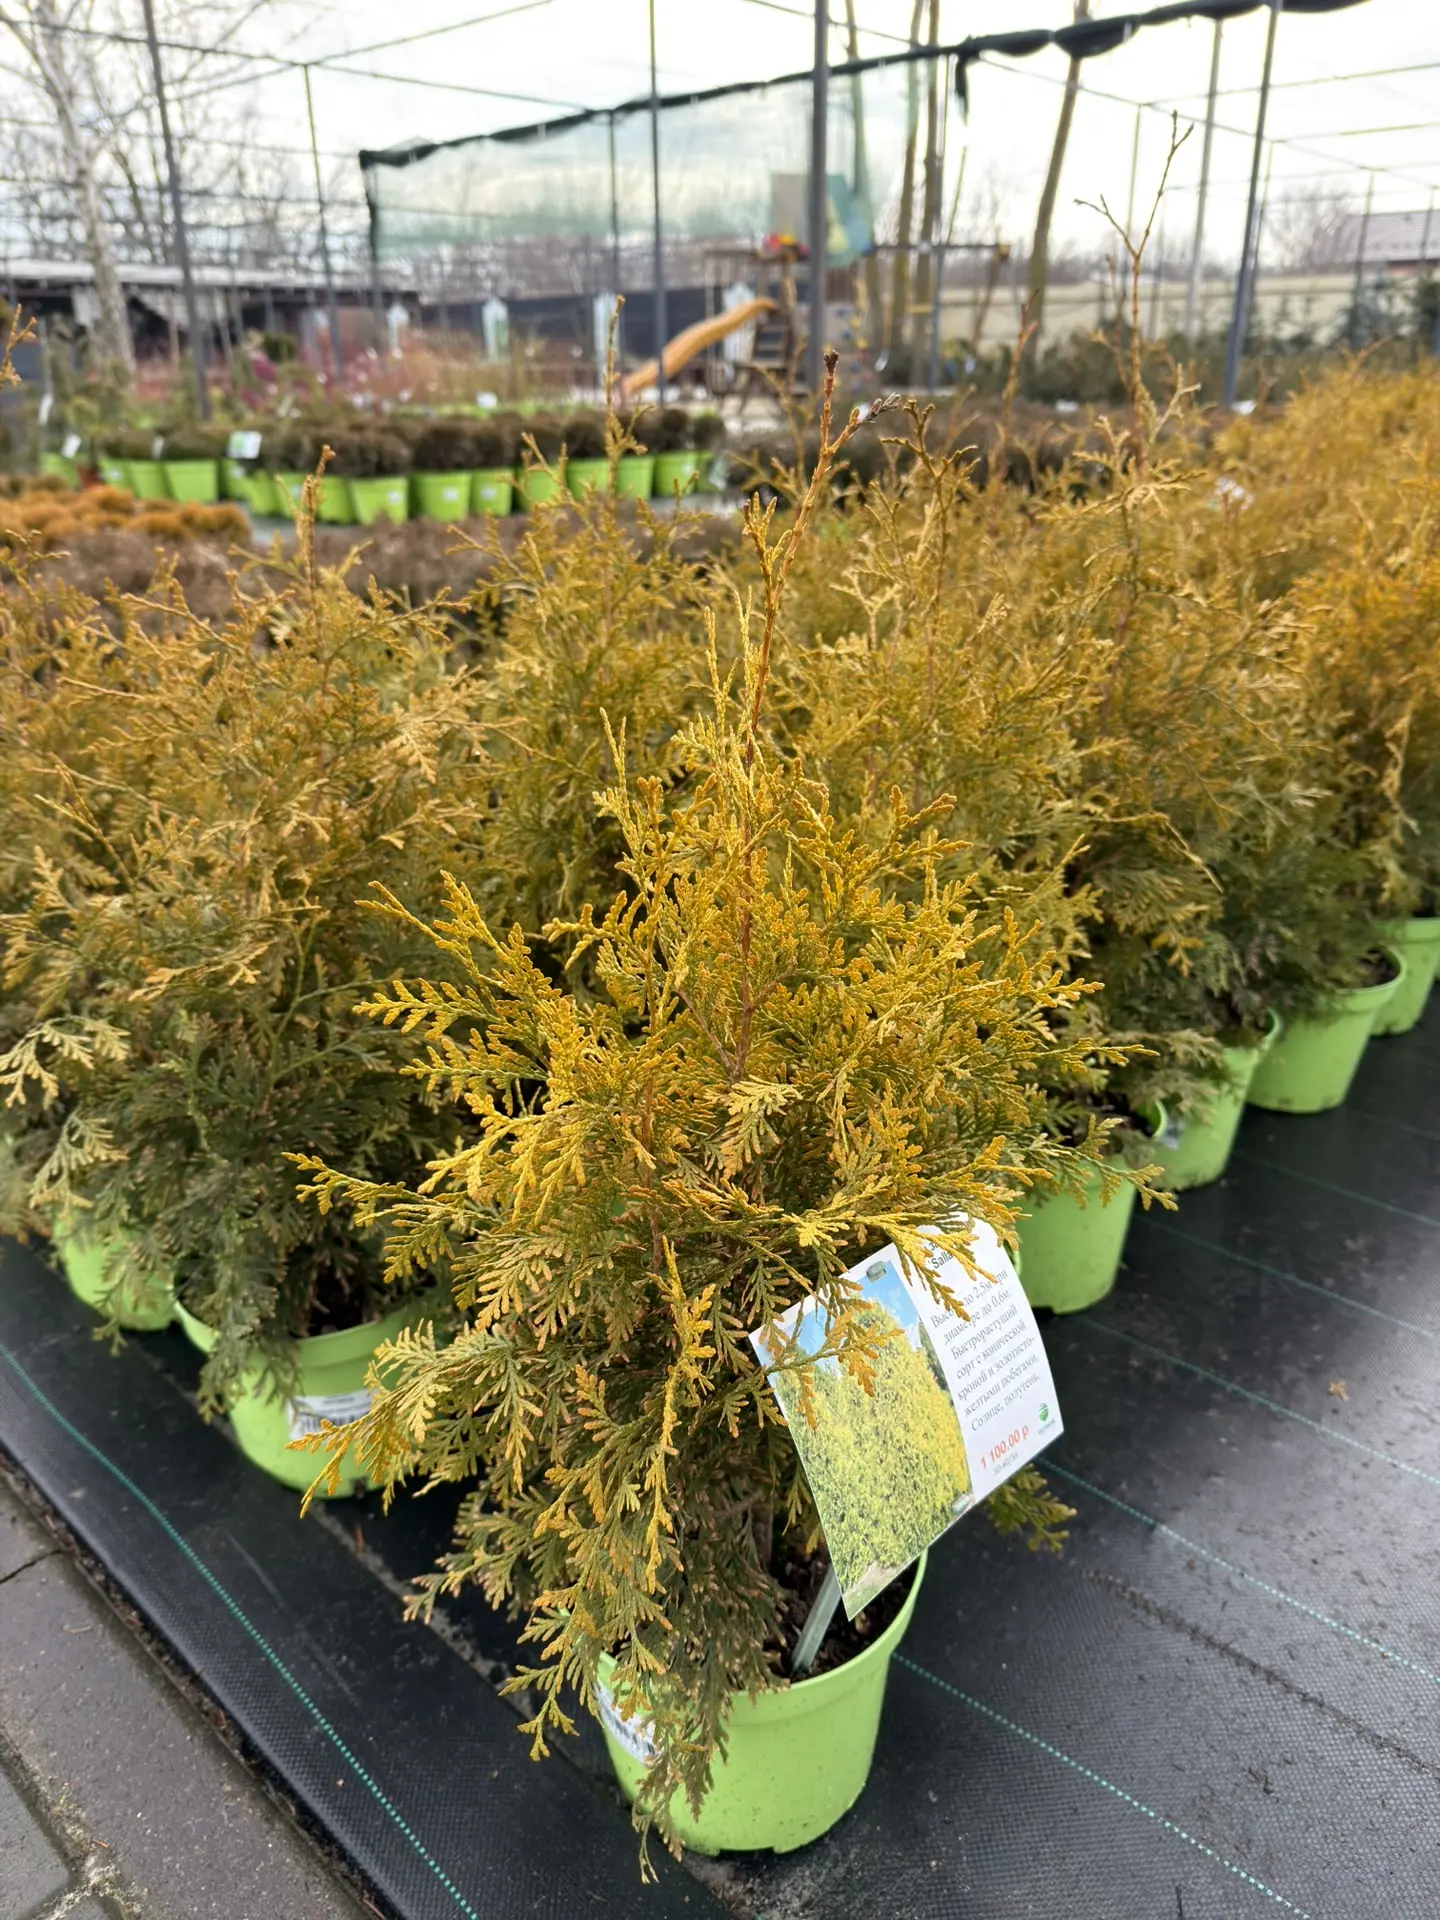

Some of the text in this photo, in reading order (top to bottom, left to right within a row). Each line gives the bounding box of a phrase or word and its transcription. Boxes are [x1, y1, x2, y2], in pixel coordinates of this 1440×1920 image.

[931, 1308, 956, 1328] Высо
[996, 1269, 1009, 1286] ри
[982, 1305, 992, 1318] до
[951, 1304, 1018, 1359] Быстрорастущий
[956, 1359, 975, 1380] сорт
[982, 1318, 1027, 1359] конической
[957, 1337, 1035, 1402] кроной и золотисто-
[964, 1382, 1001, 1417] желтыми
[980, 1455, 987, 1470] 1
[989, 1429, 1020, 1462] 100.00
